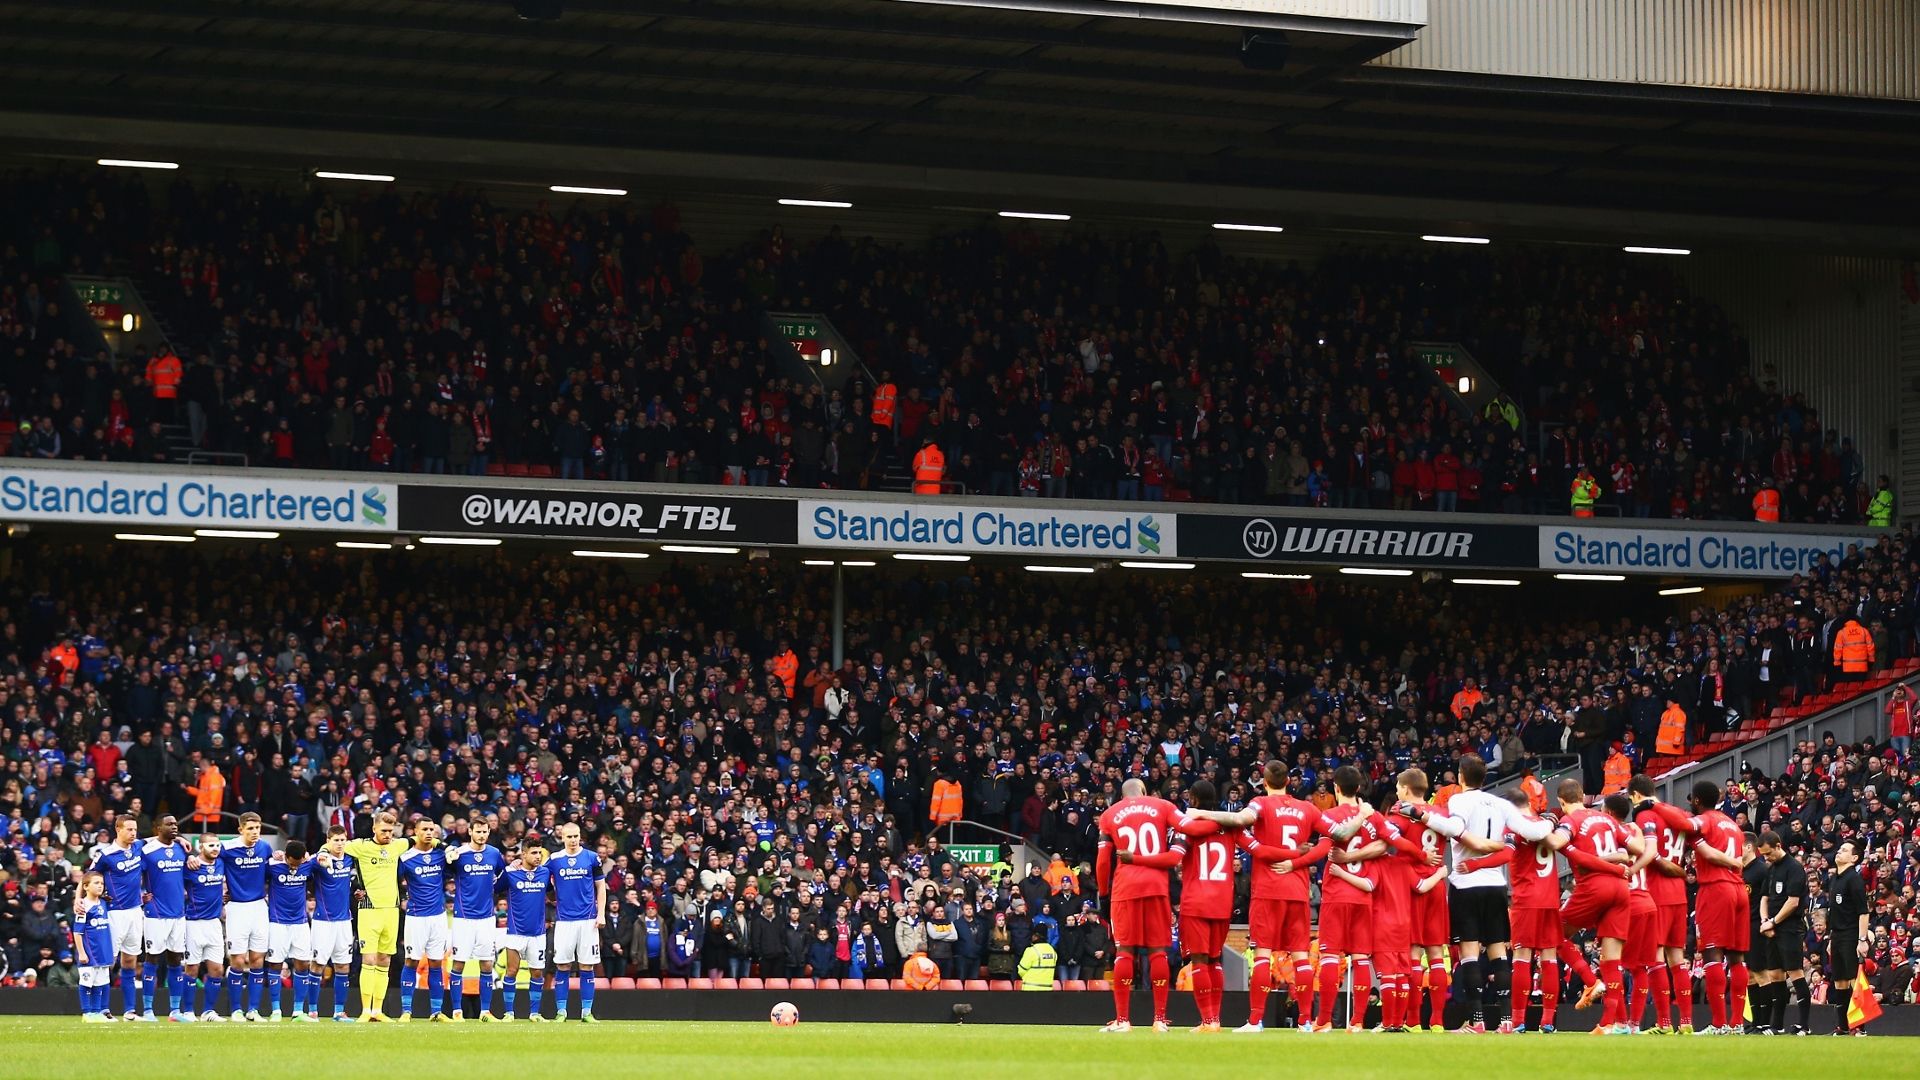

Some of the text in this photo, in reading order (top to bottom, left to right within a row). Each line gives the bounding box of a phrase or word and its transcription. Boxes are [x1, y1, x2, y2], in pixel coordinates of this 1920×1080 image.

[2, 476, 355, 522] Standard Chartered
[461, 494, 737, 534] @WARRIOR_FTBL
[813, 506, 1132, 550] Standard Chartered
[1281, 526, 1474, 558] WARRIOR
[1554, 531, 1844, 573] Standard Chartered
[1113, 805, 1158, 824] CISSOKHO
[1275, 807, 1305, 819] AGGER
[1118, 822, 1161, 857] 20
[1282, 825, 1299, 850] 5
[1486, 817, 1492, 839] 1
[950, 849, 981, 862] EXIT
[1592, 830, 1618, 857] 14
[1663, 828, 1687, 865] 34
[1725, 836, 1736, 859] 4
[566, 867, 588, 876] Blacks
[1198, 841, 1228, 881] 12
[1535, 845, 1554, 878] 9
[524, 880, 546, 889] Blacks
[591, 944, 599, 956] 12
